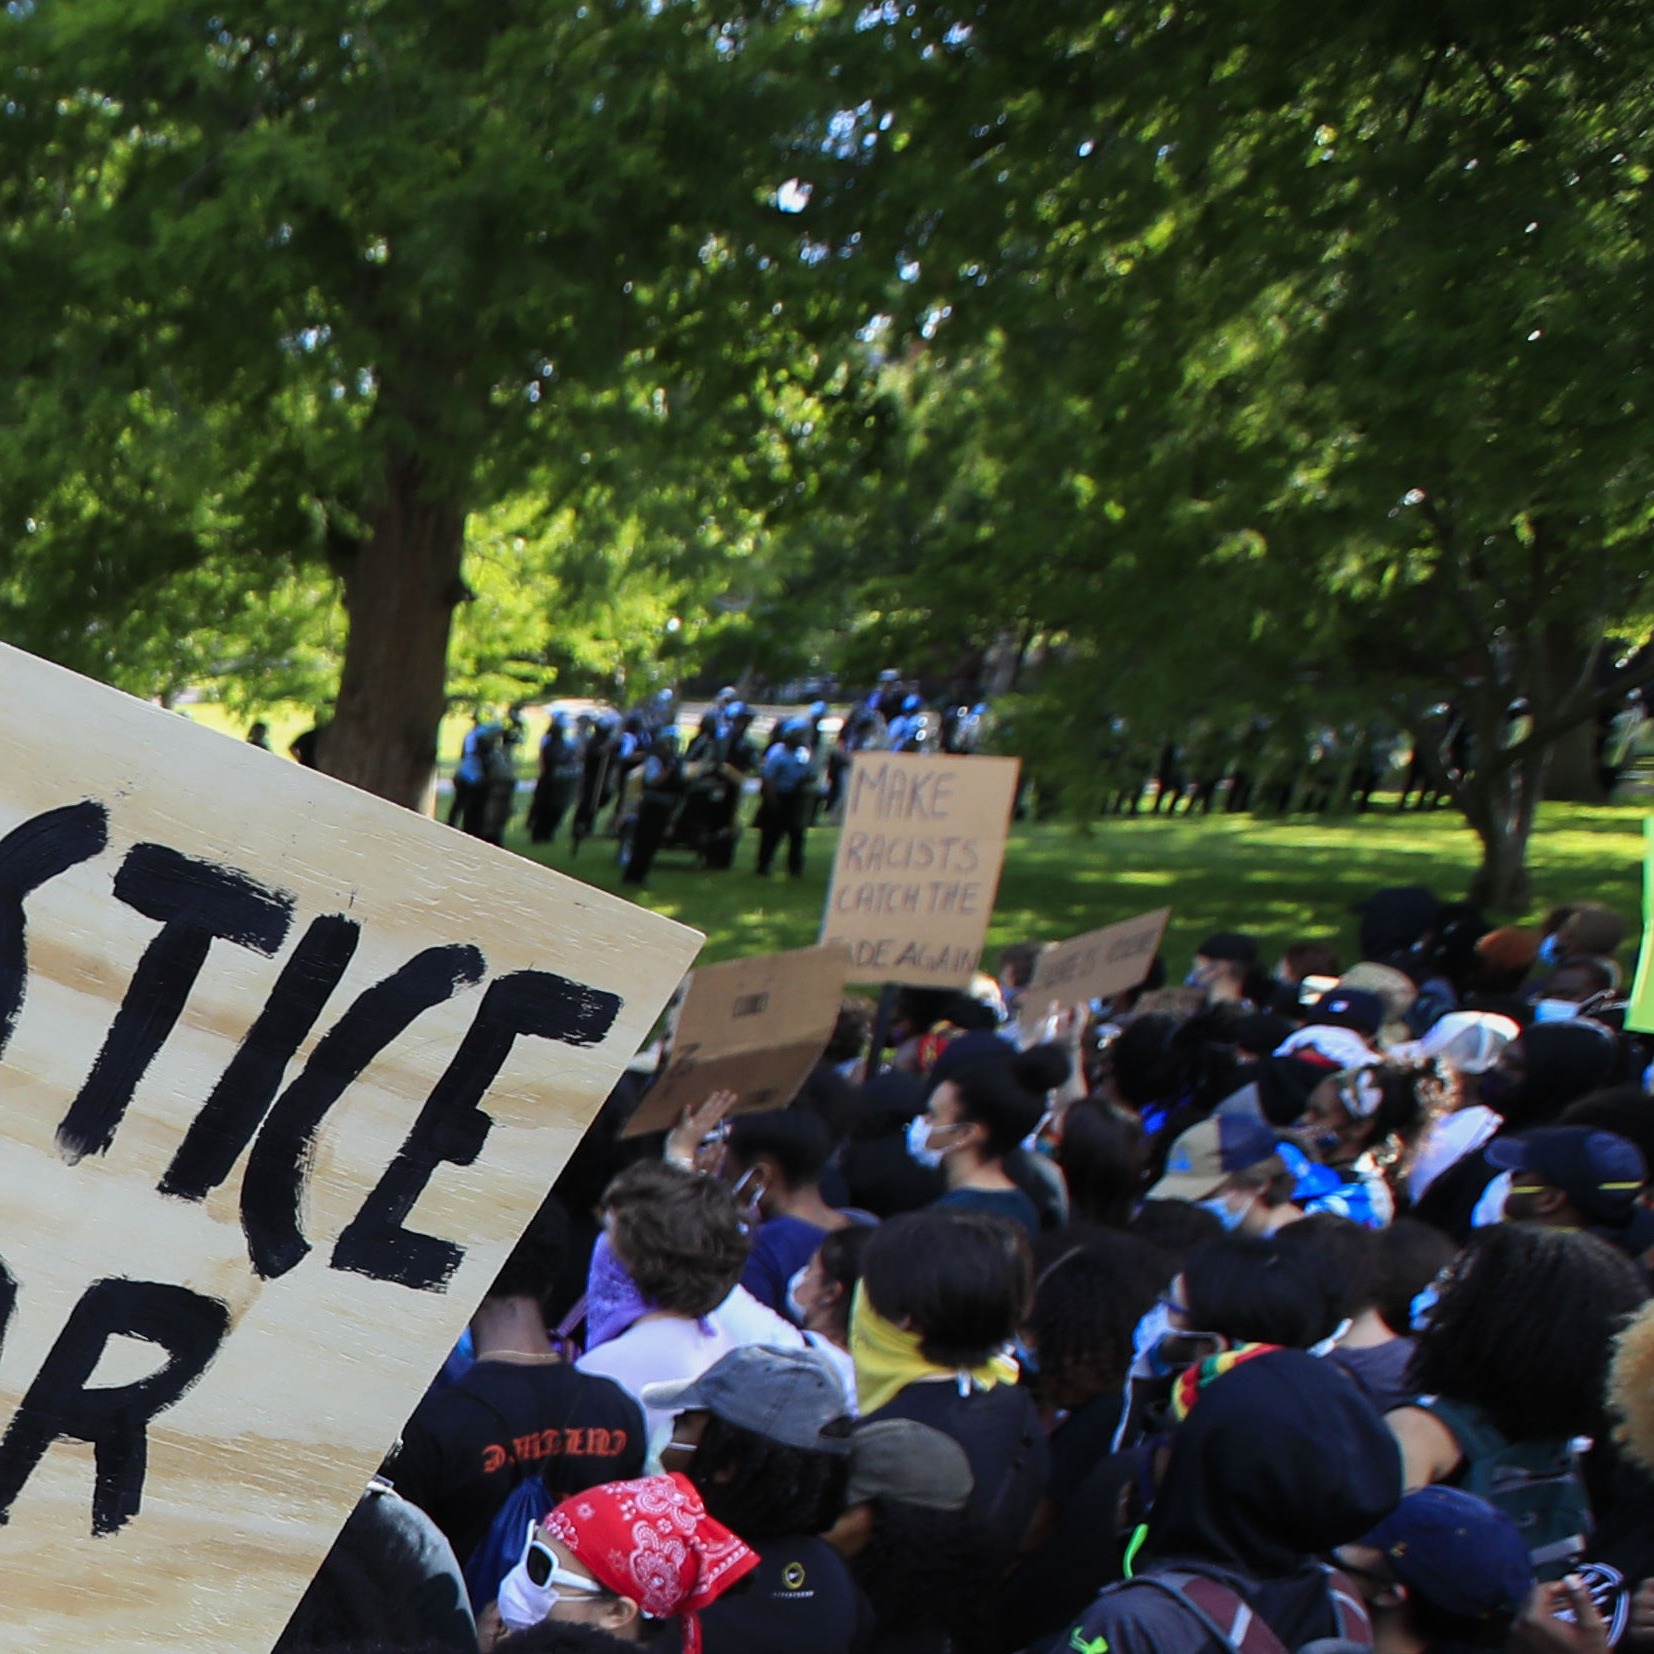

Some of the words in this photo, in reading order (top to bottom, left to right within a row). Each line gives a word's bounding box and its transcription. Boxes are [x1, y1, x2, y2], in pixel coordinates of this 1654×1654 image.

[851, 763, 956, 820] MAKE
[844, 831, 981, 875] RACISTS
[928, 880, 982, 915] THE
